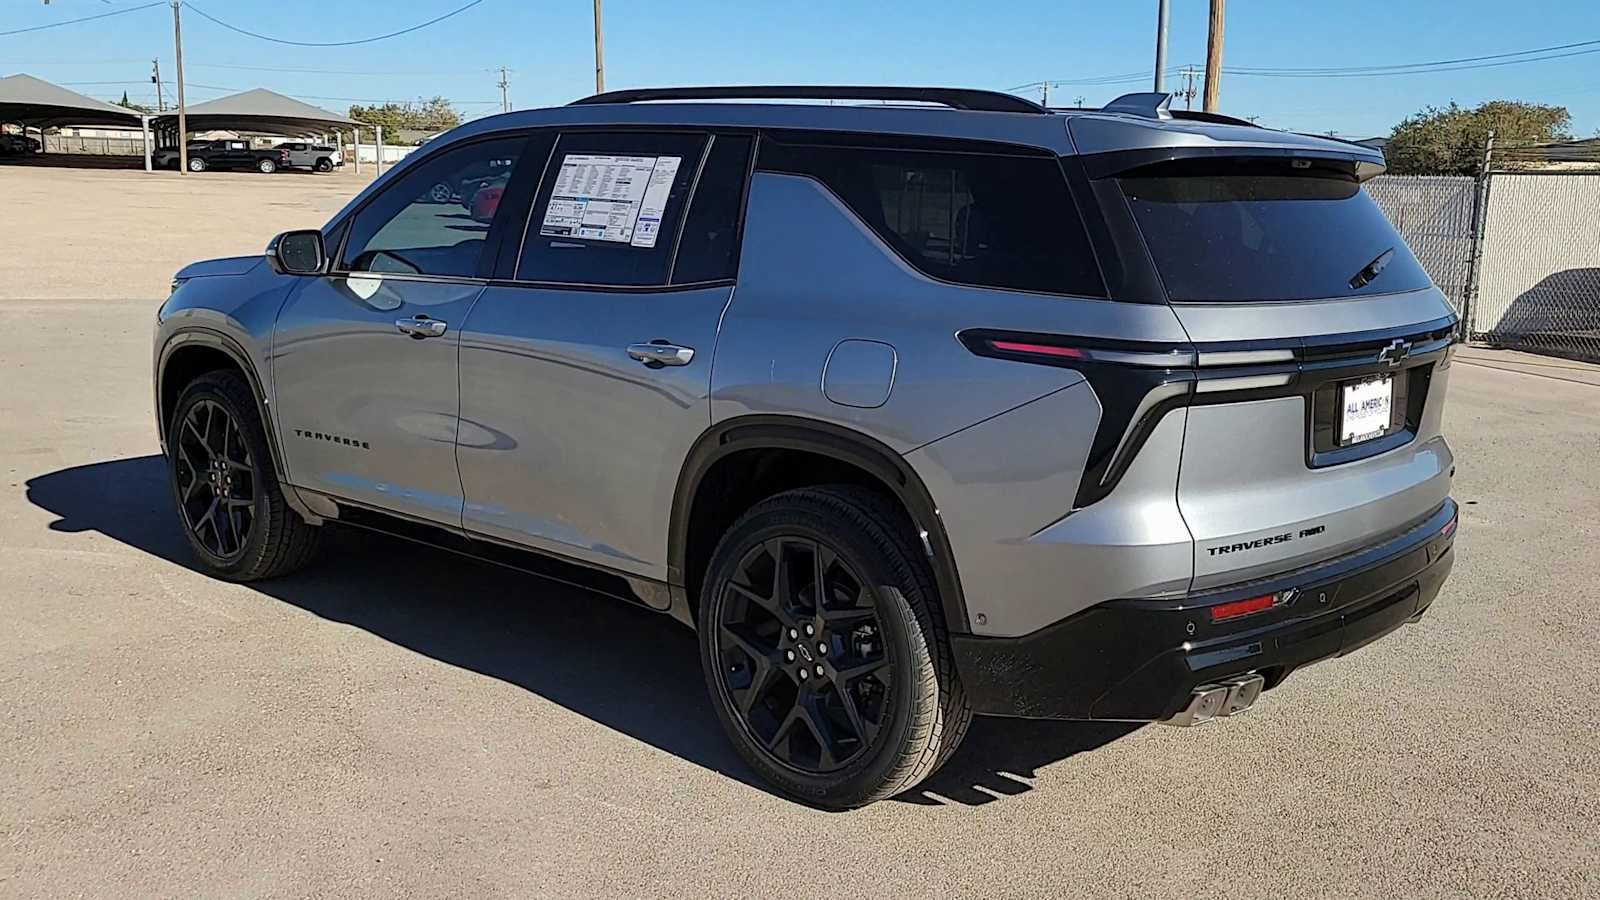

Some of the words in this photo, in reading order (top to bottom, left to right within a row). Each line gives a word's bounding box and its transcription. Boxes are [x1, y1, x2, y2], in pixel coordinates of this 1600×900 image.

[1347, 402, 1359, 413] ALL
[293, 429, 370, 449] TRAVERSE
[1207, 532, 1292, 556] TRAVERSE
[1299, 525, 1325, 538] AWD
